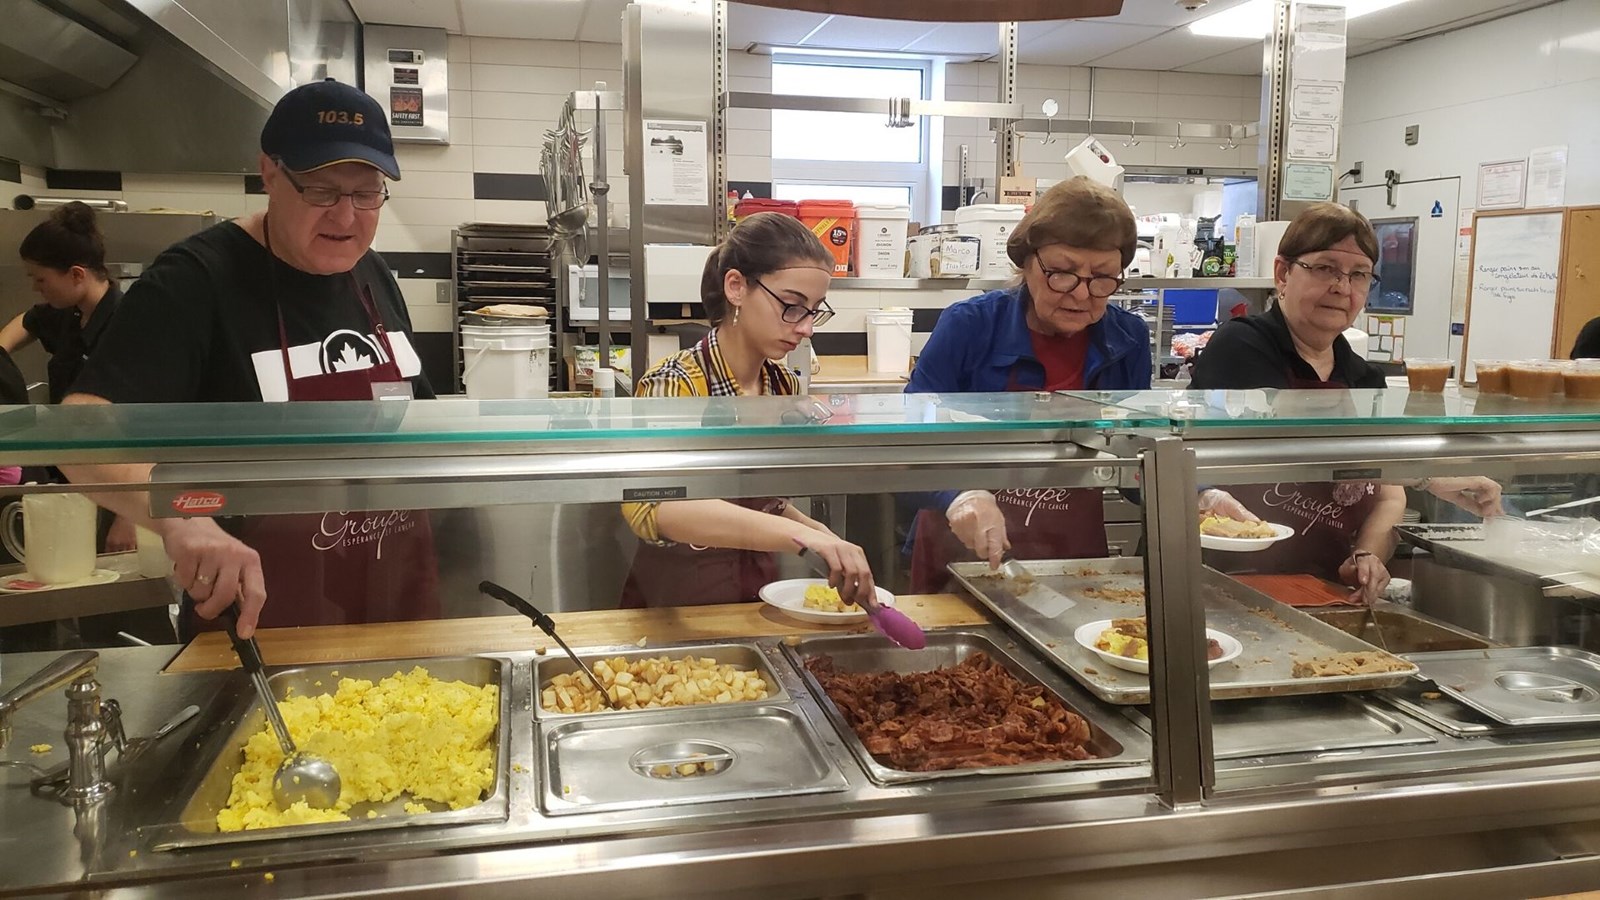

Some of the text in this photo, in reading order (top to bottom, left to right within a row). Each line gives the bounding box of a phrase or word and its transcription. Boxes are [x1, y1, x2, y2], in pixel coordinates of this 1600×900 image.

[317, 111, 365, 126] 103.5
[172, 496, 222, 509] Hatco
[1262, 482, 1344, 536] Groupe
[311, 509, 409, 560] Groupe
